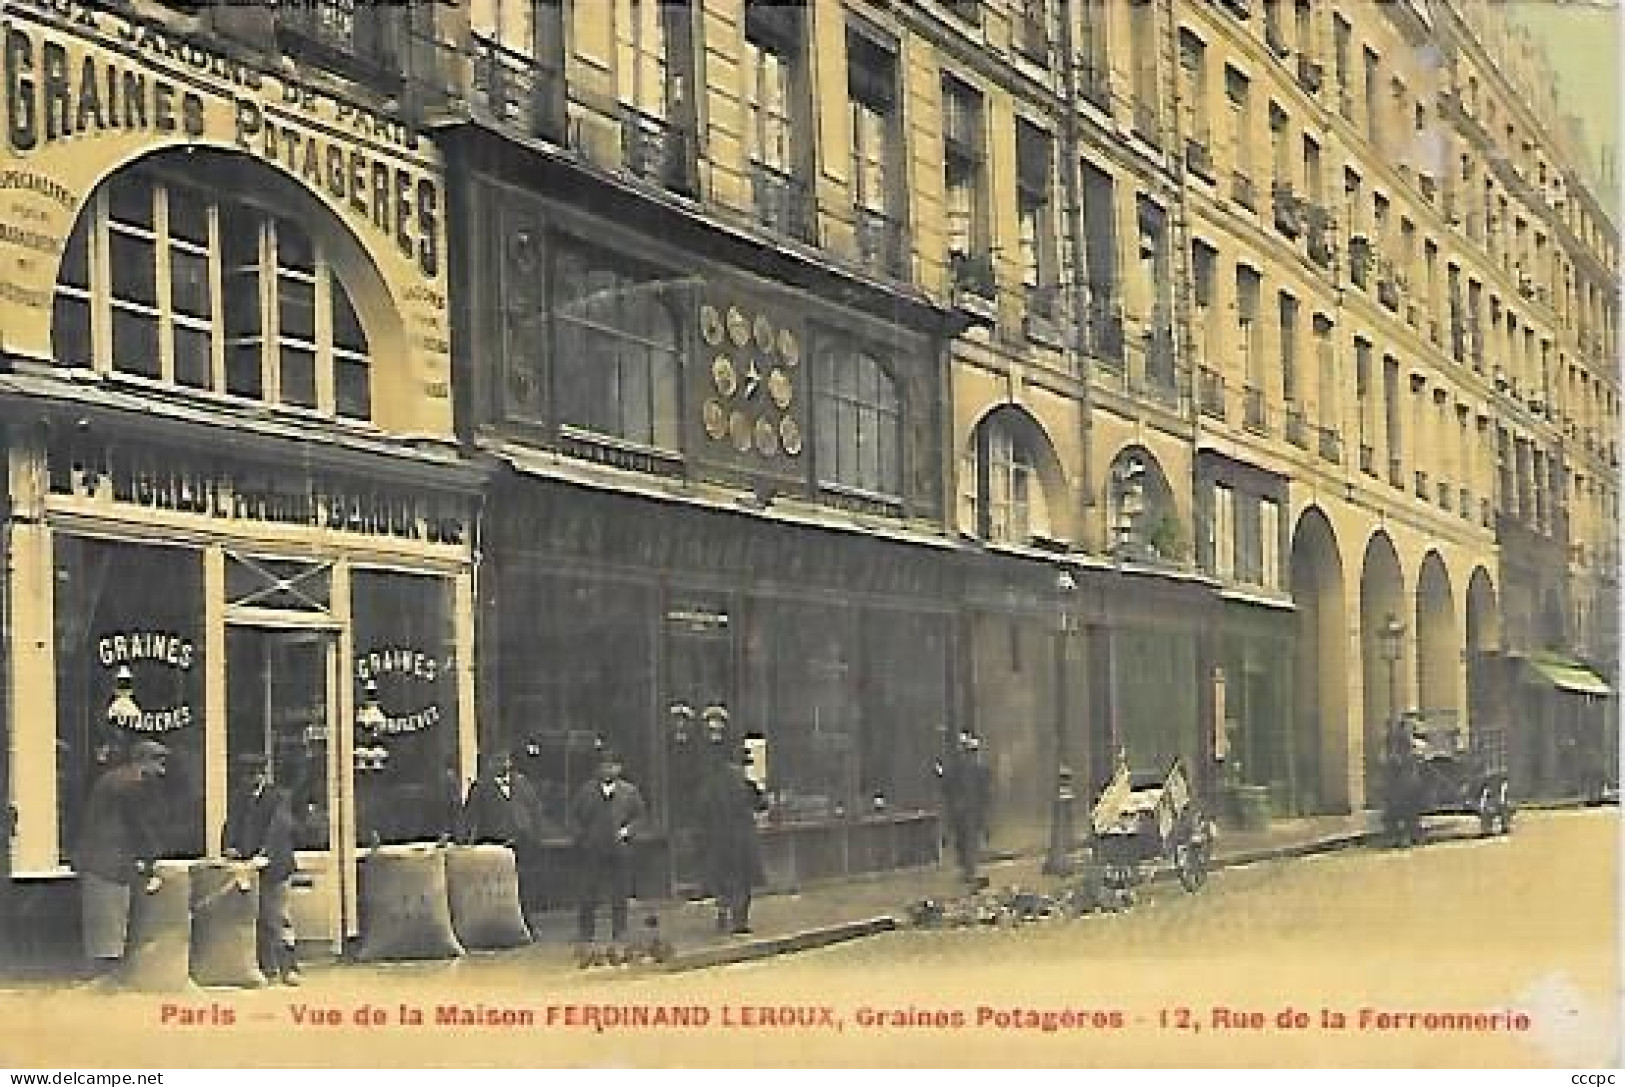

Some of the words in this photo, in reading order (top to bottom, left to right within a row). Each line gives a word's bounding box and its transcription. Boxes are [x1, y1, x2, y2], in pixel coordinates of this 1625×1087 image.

[5, 26, 204, 152] GRAINES
[234, 96, 438, 278] POTAGERES
[100, 632, 193, 670] GRAINES
[357, 650, 436, 682] GRAINES
